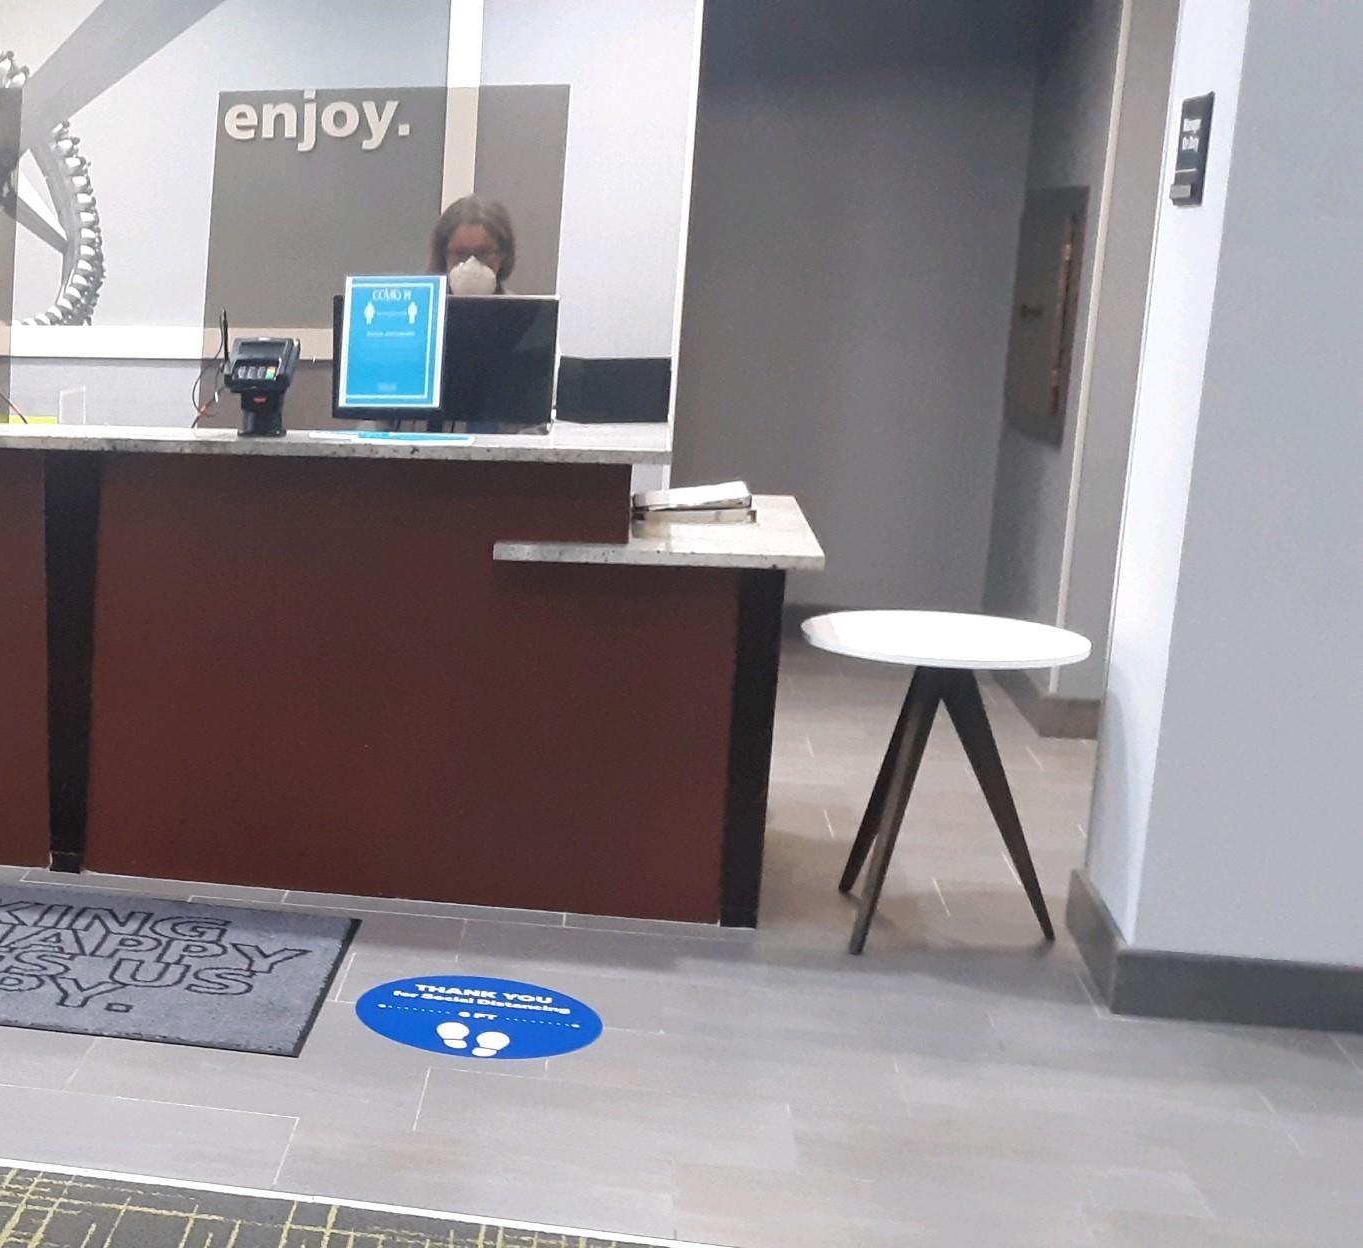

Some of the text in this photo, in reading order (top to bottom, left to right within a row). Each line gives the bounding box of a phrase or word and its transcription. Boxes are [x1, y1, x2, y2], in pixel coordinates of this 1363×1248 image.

[224, 89, 410, 152] enjoy.
[109, 958, 258, 995] US
[393, 990, 571, 1015] for Social Distancing
[414, 983, 553, 1004] THANK YOU
[458, 1010, 498, 1020] 6 FT
